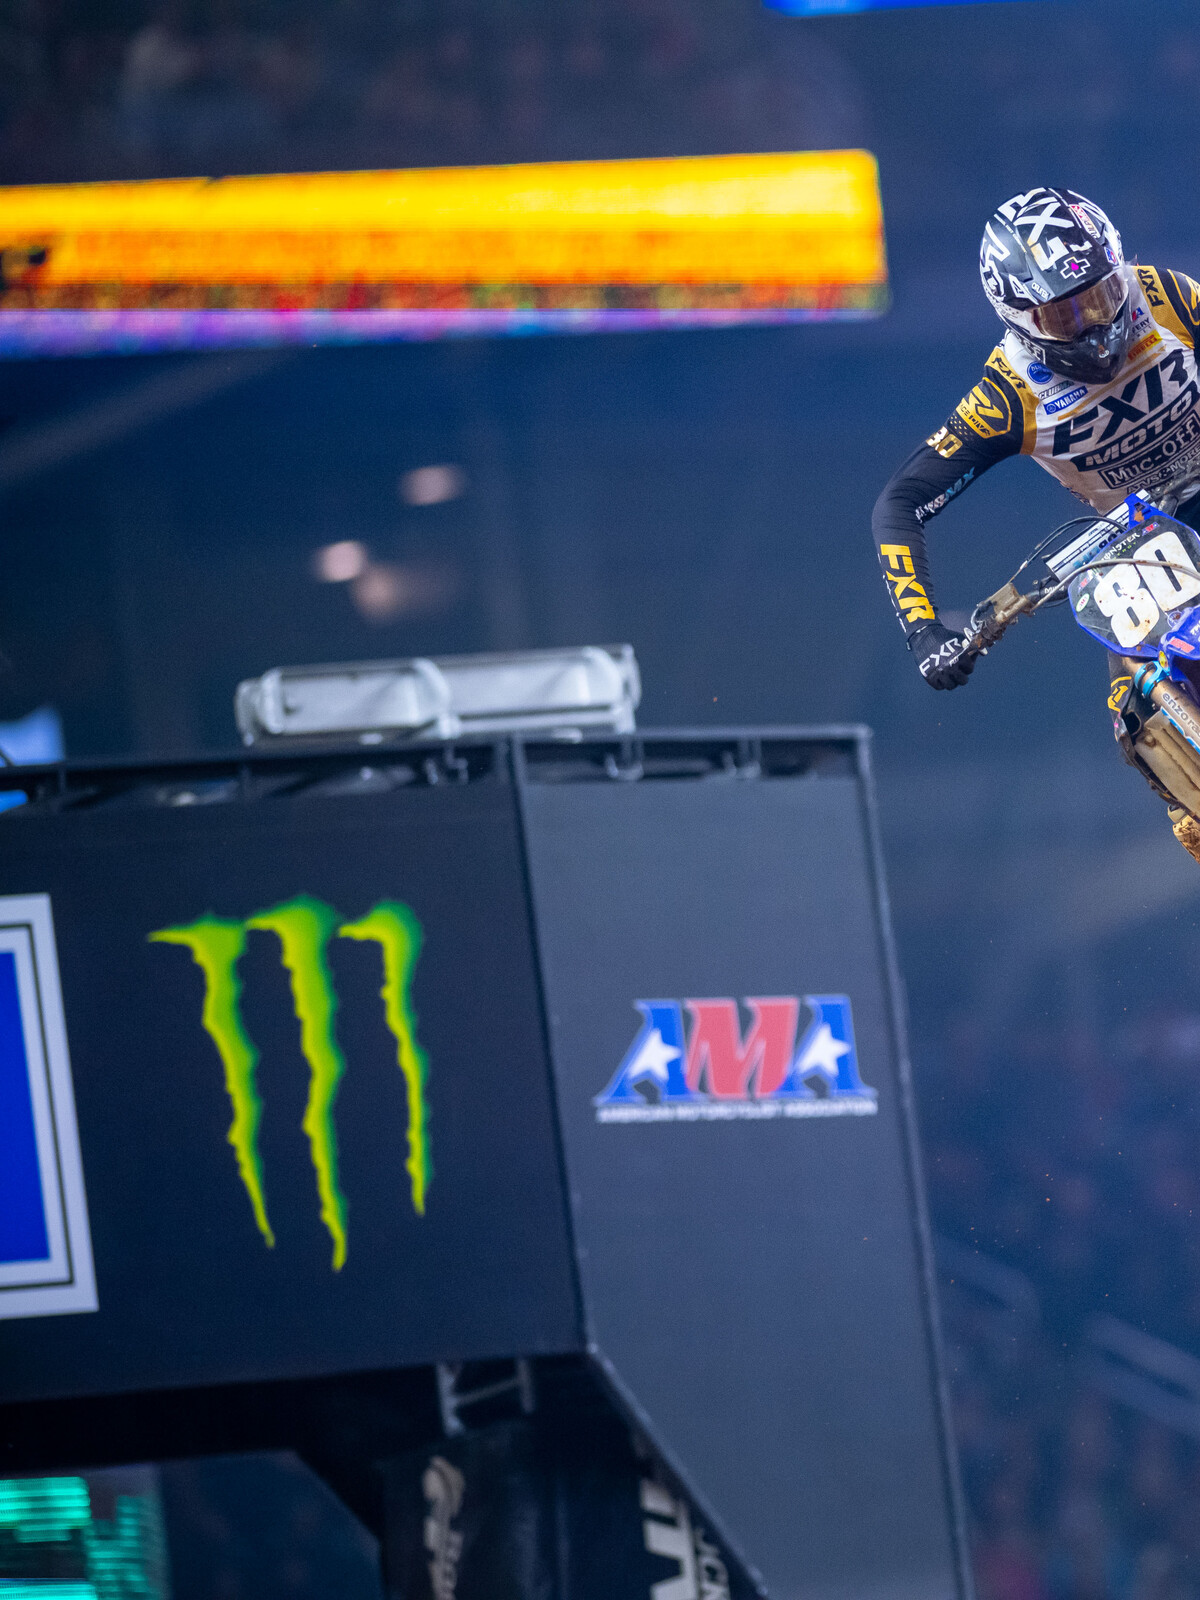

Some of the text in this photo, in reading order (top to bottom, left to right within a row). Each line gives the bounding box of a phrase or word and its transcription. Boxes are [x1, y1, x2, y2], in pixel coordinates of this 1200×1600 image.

[1137, 269, 1165, 307] FXR
[992, 357, 1027, 390] FXR
[1054, 387, 1086, 408] YAMAHA
[1053, 348, 1189, 457] FXR
[1085, 390, 1193, 467] MOTO
[1107, 417, 1200, 485] Muc-Off
[880, 543, 936, 623] FXR
[919, 637, 962, 678] FXR
[1162, 692, 1190, 721] enzo
[590, 995, 879, 1106] AMA
